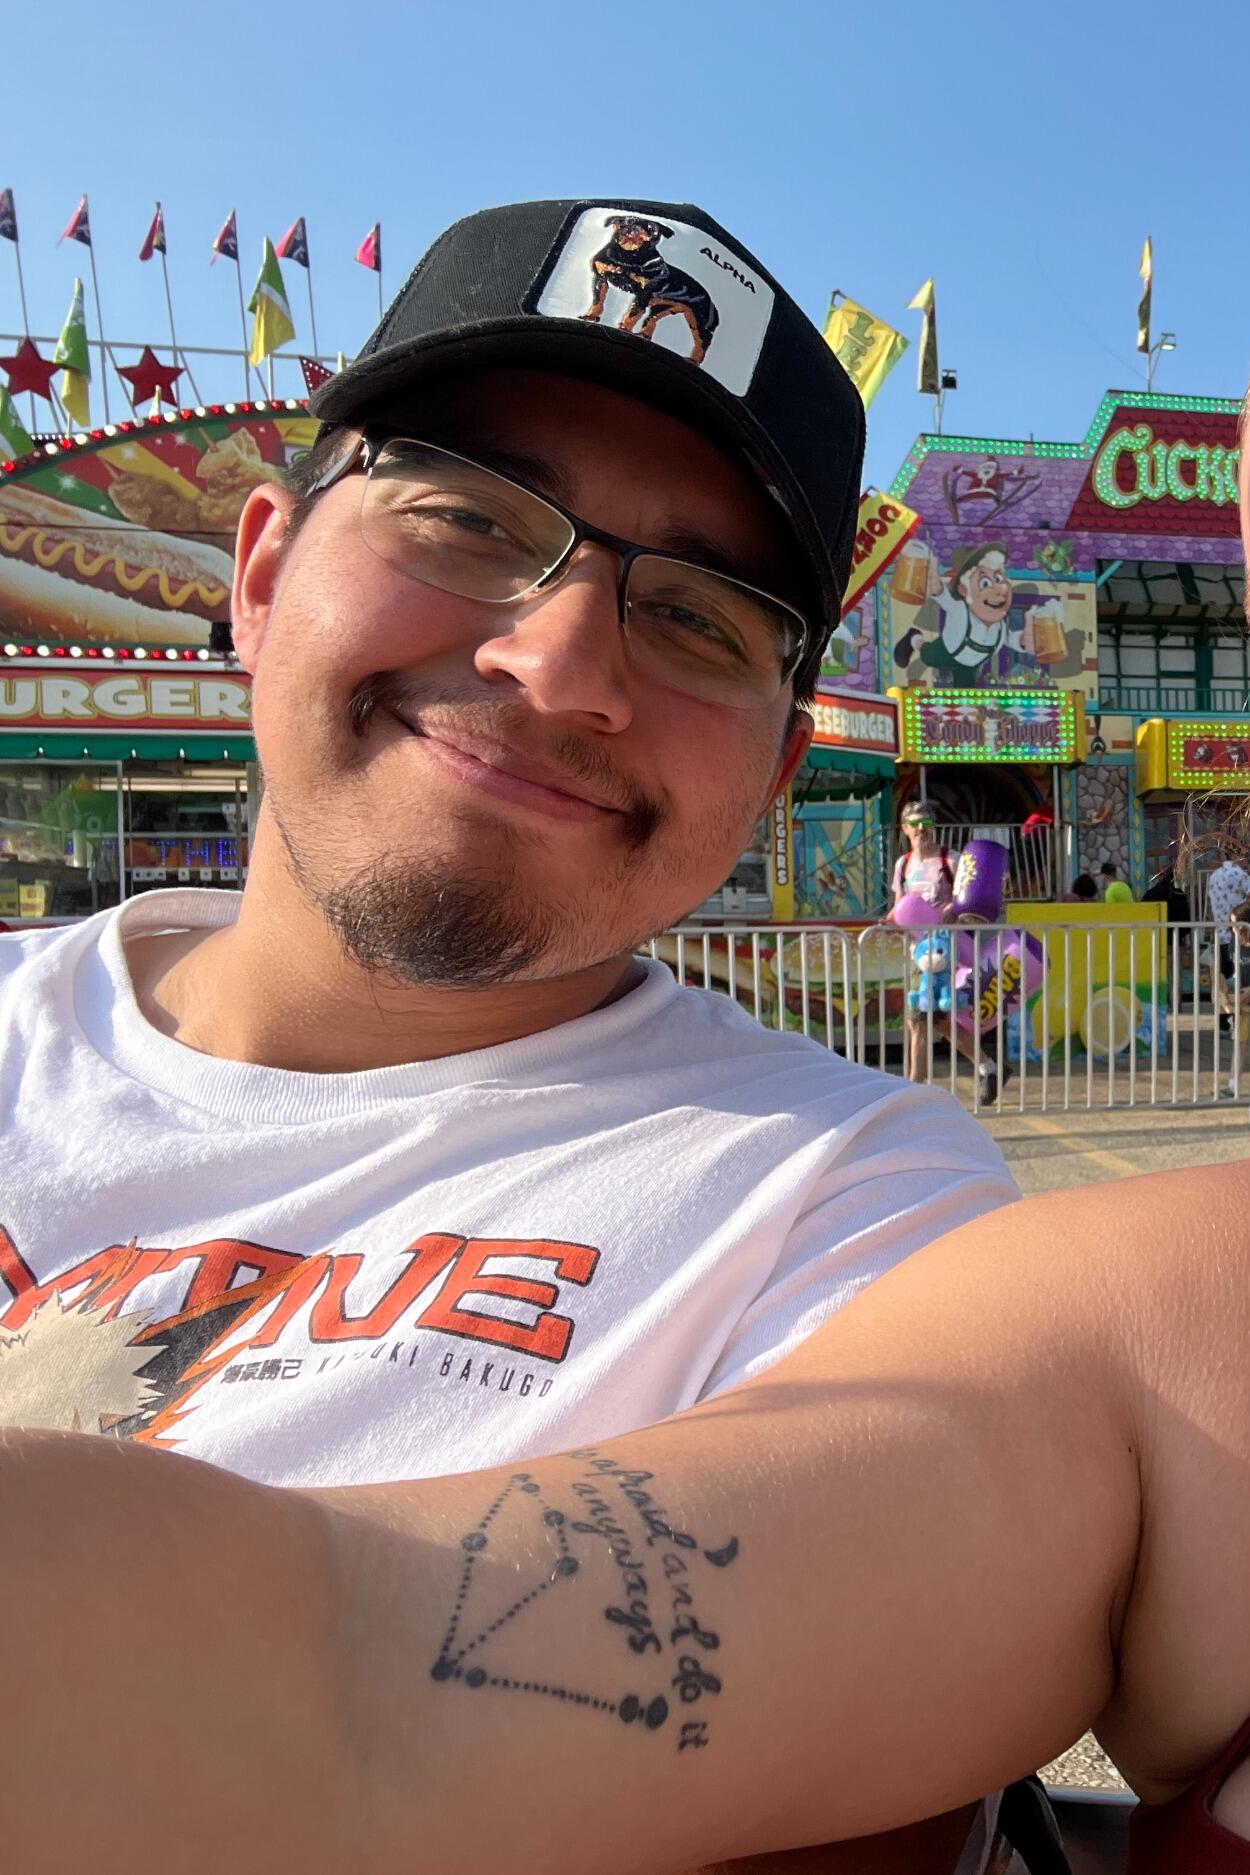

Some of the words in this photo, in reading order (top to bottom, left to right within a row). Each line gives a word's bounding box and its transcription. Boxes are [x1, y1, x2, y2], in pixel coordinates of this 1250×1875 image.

[700, 247, 756, 294] ALPHA
[0, 674, 251, 720] URGER
[569, 1483, 662, 1655] anyways
[661, 1551, 721, 1650] and
[677, 1720, 710, 1754] it
